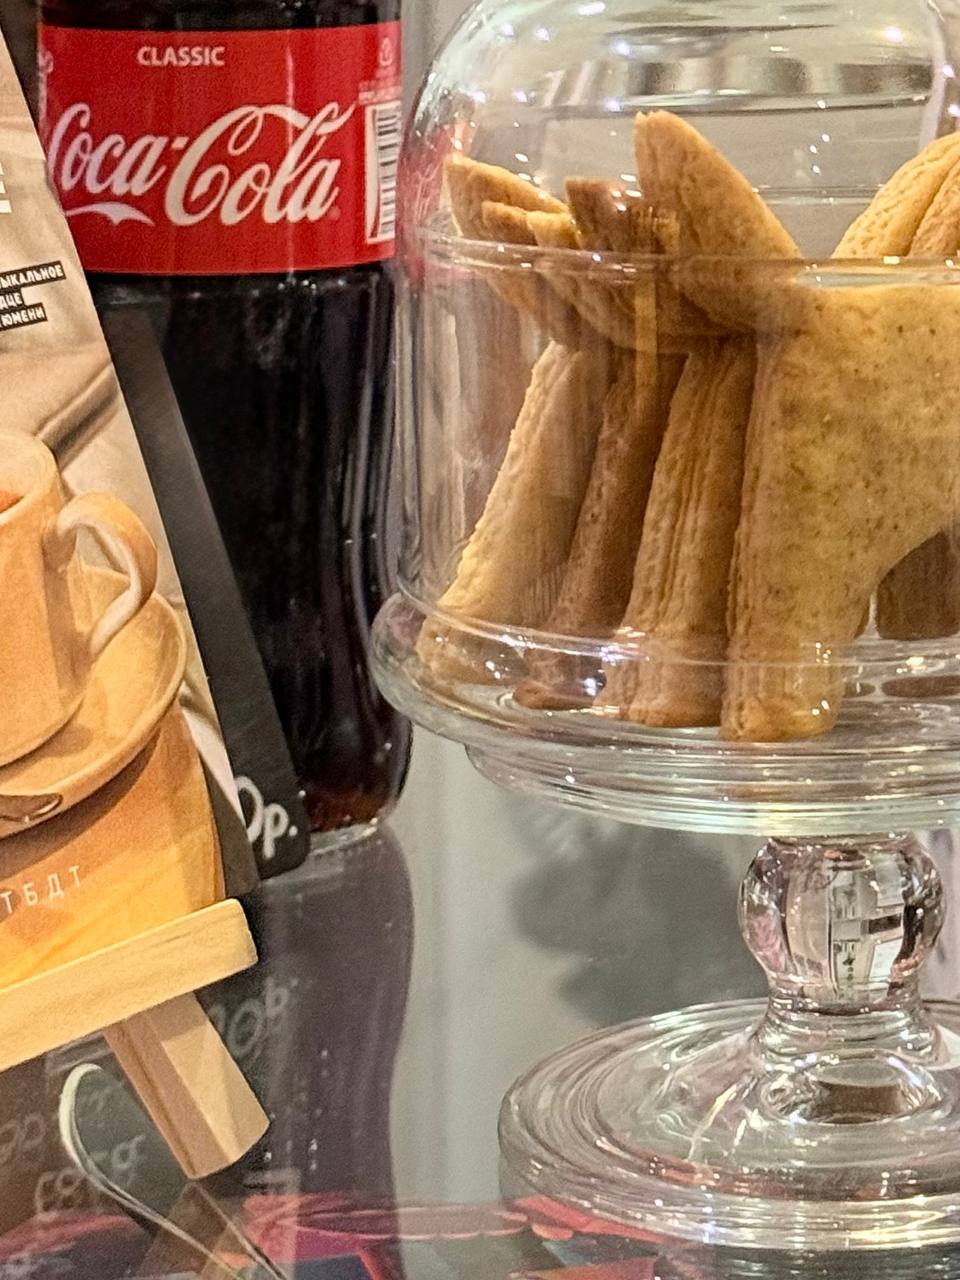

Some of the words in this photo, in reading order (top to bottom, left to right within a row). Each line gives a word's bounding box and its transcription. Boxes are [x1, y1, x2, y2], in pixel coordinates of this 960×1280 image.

[137, 46, 225, 67] CLASSIC
[47, 102, 357, 227] Coca-Cola
[0, 265, 63, 288] ЫКАЛЬНОЕ
[0, 293, 23, 309] ДЦЕ
[0, 307, 45, 327] ЮМЕНИ
